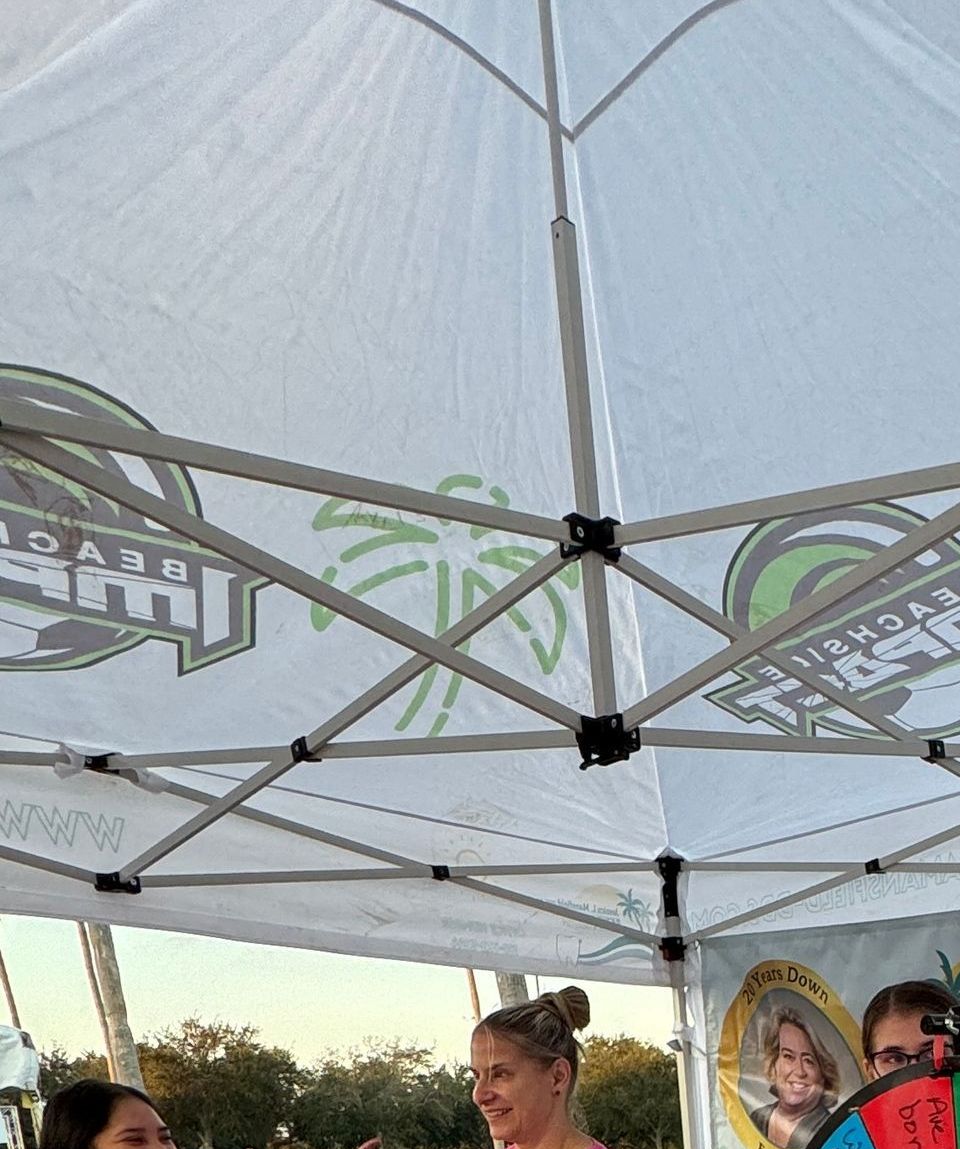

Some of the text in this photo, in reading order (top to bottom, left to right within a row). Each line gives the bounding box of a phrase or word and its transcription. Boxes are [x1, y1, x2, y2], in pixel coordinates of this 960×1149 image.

[742, 966, 830, 1006] 20 Years Down
